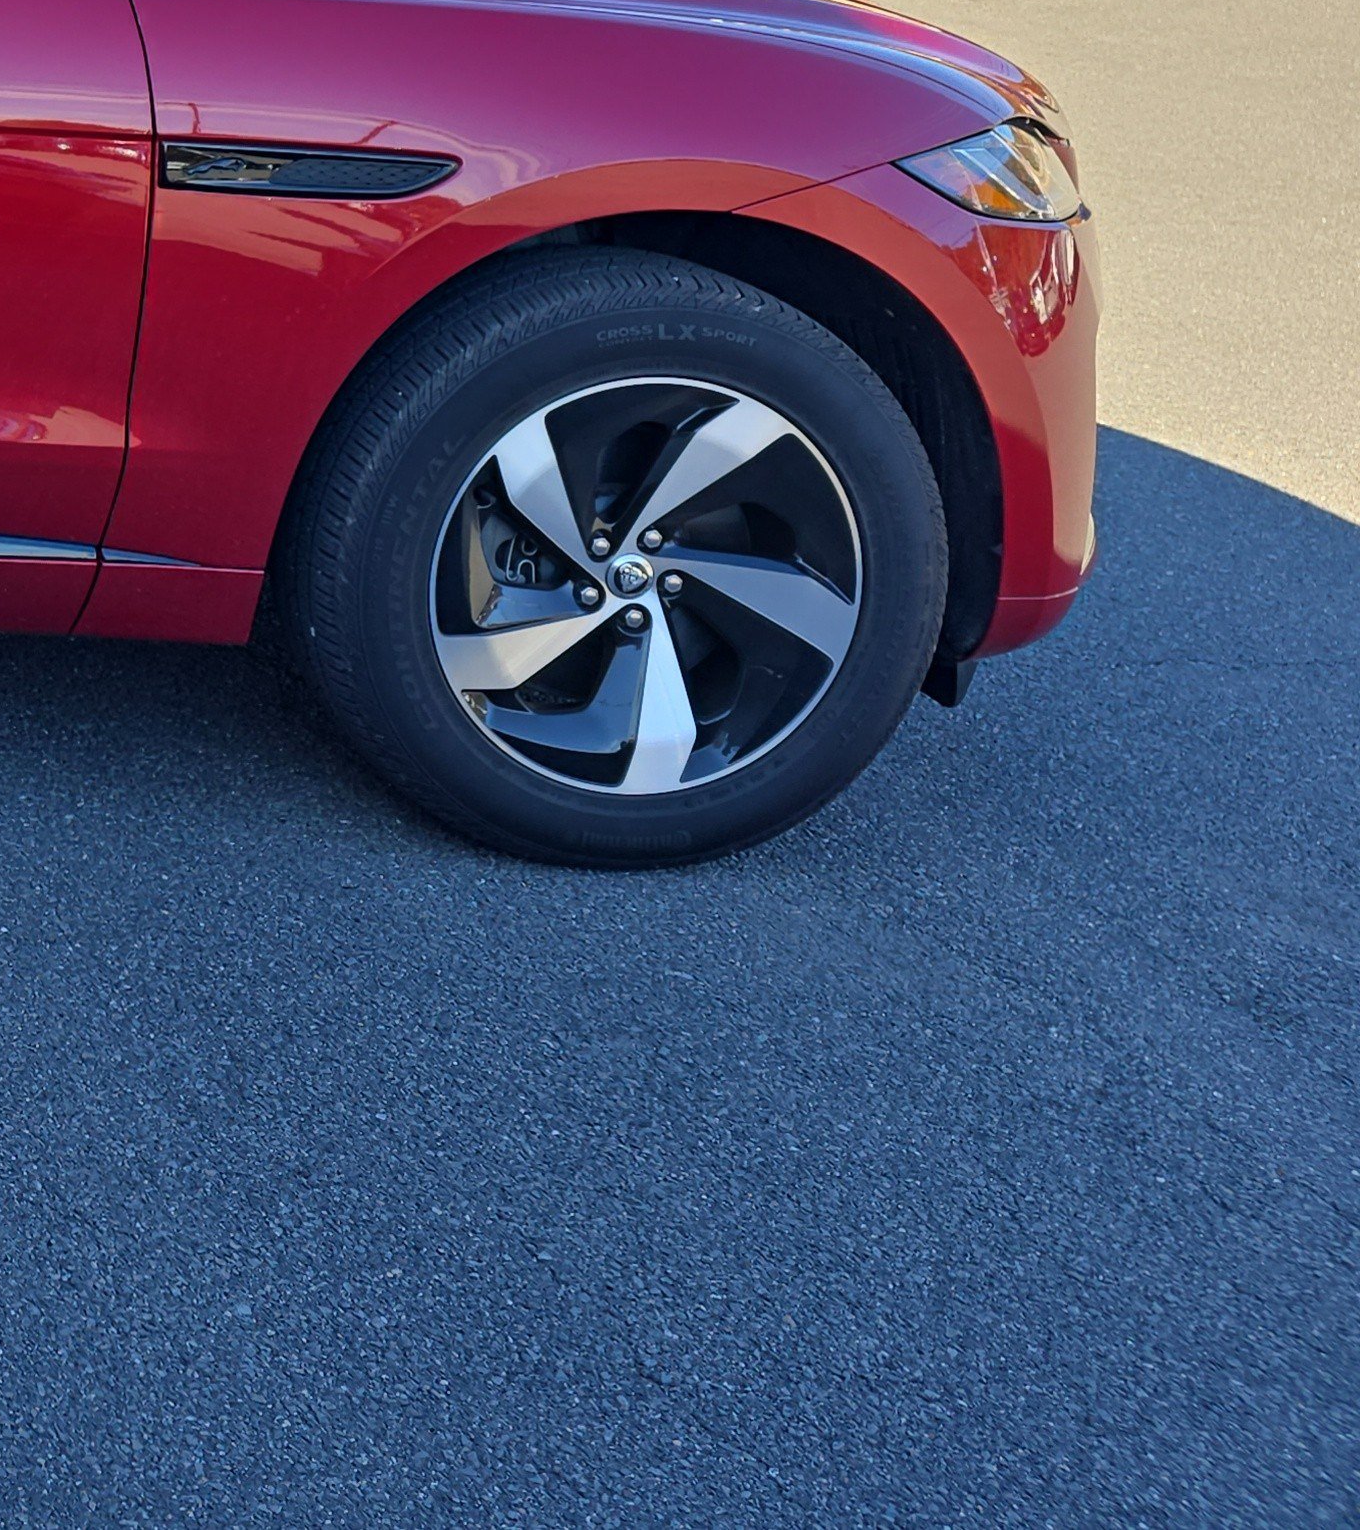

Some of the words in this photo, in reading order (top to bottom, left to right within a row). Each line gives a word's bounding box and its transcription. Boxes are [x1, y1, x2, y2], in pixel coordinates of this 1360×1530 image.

[596, 324, 654, 342] CROSS
[657, 323, 697, 342] LX
[701, 326, 758, 347] SPORT
